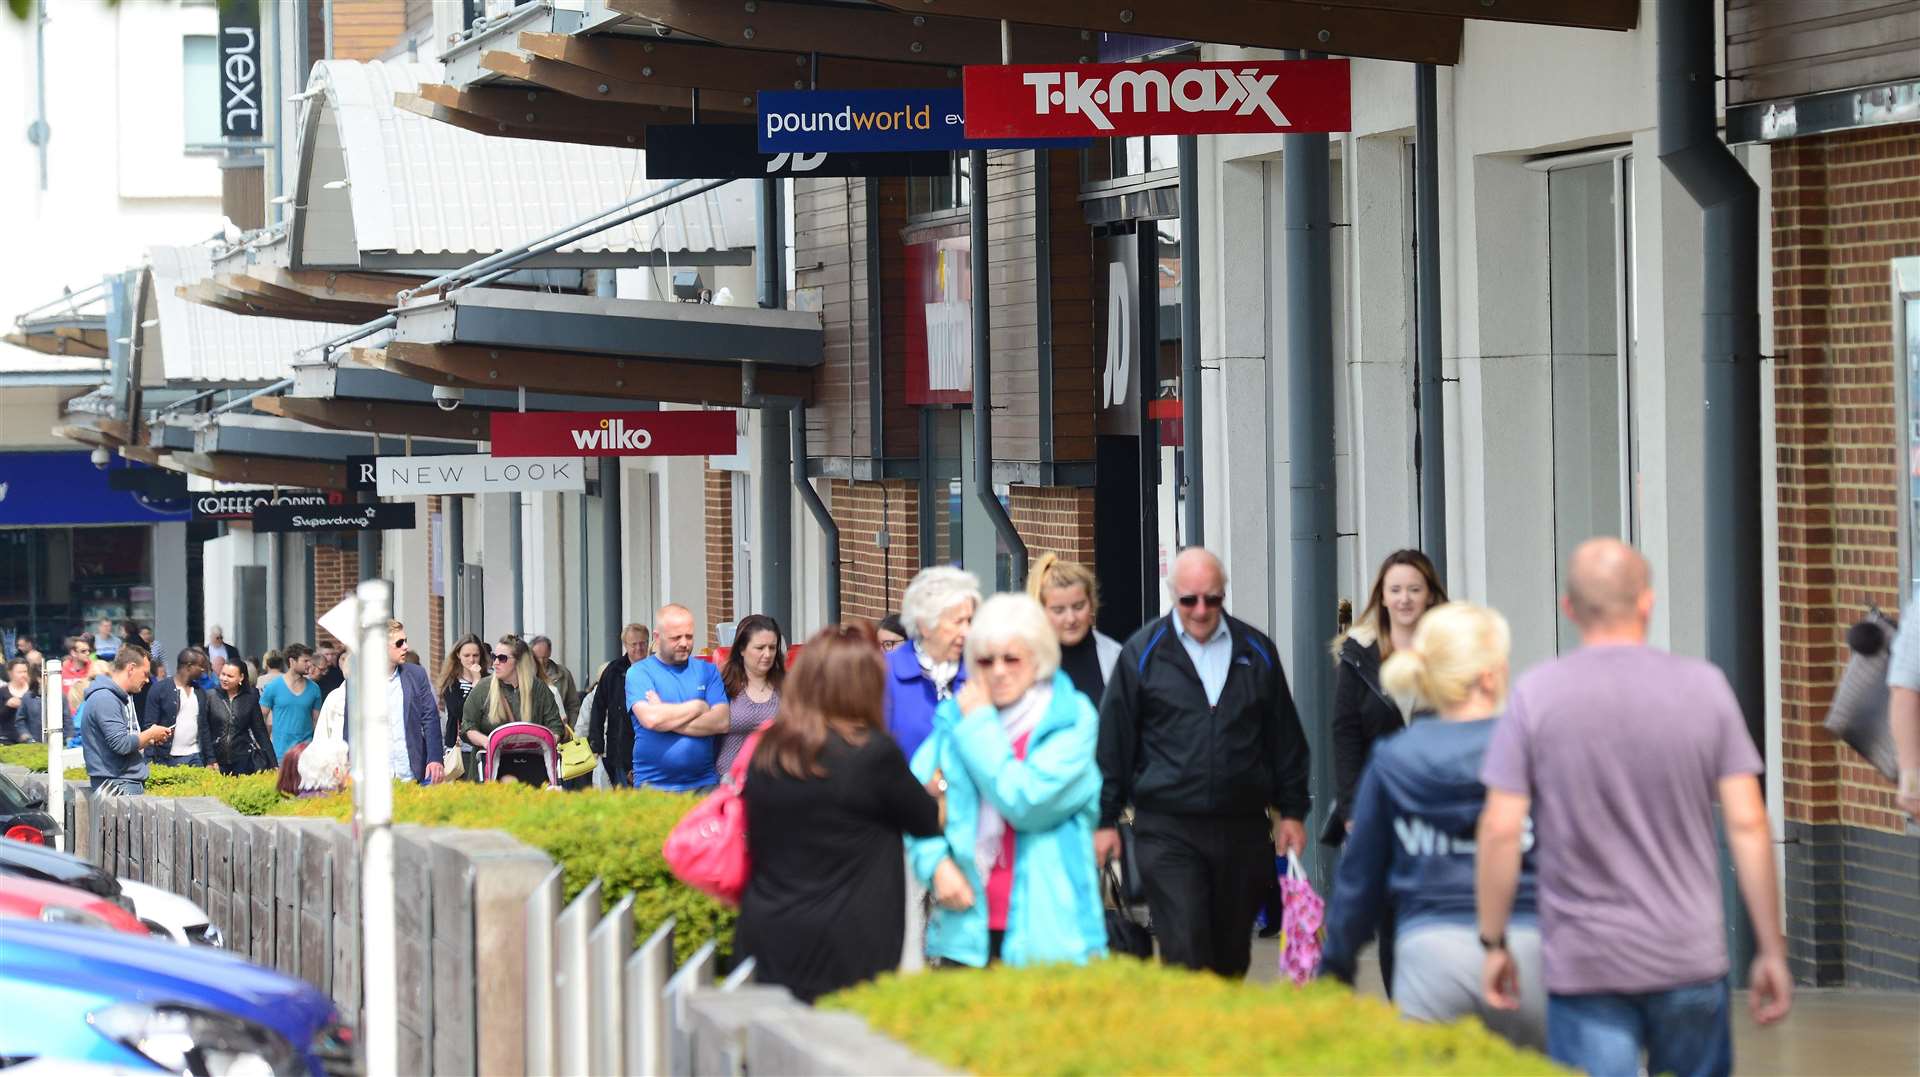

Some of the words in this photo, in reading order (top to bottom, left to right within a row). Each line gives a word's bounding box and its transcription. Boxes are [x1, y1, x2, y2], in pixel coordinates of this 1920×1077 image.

[225, 27, 259, 130] next
[767, 104, 931, 138] poundworld
[571, 418, 652, 450] wilko
[392, 465, 464, 484] NEW
[484, 462, 570, 483] LOOK
[197, 496, 254, 514] COFFEE
[292, 515, 369, 528] Superdrug
